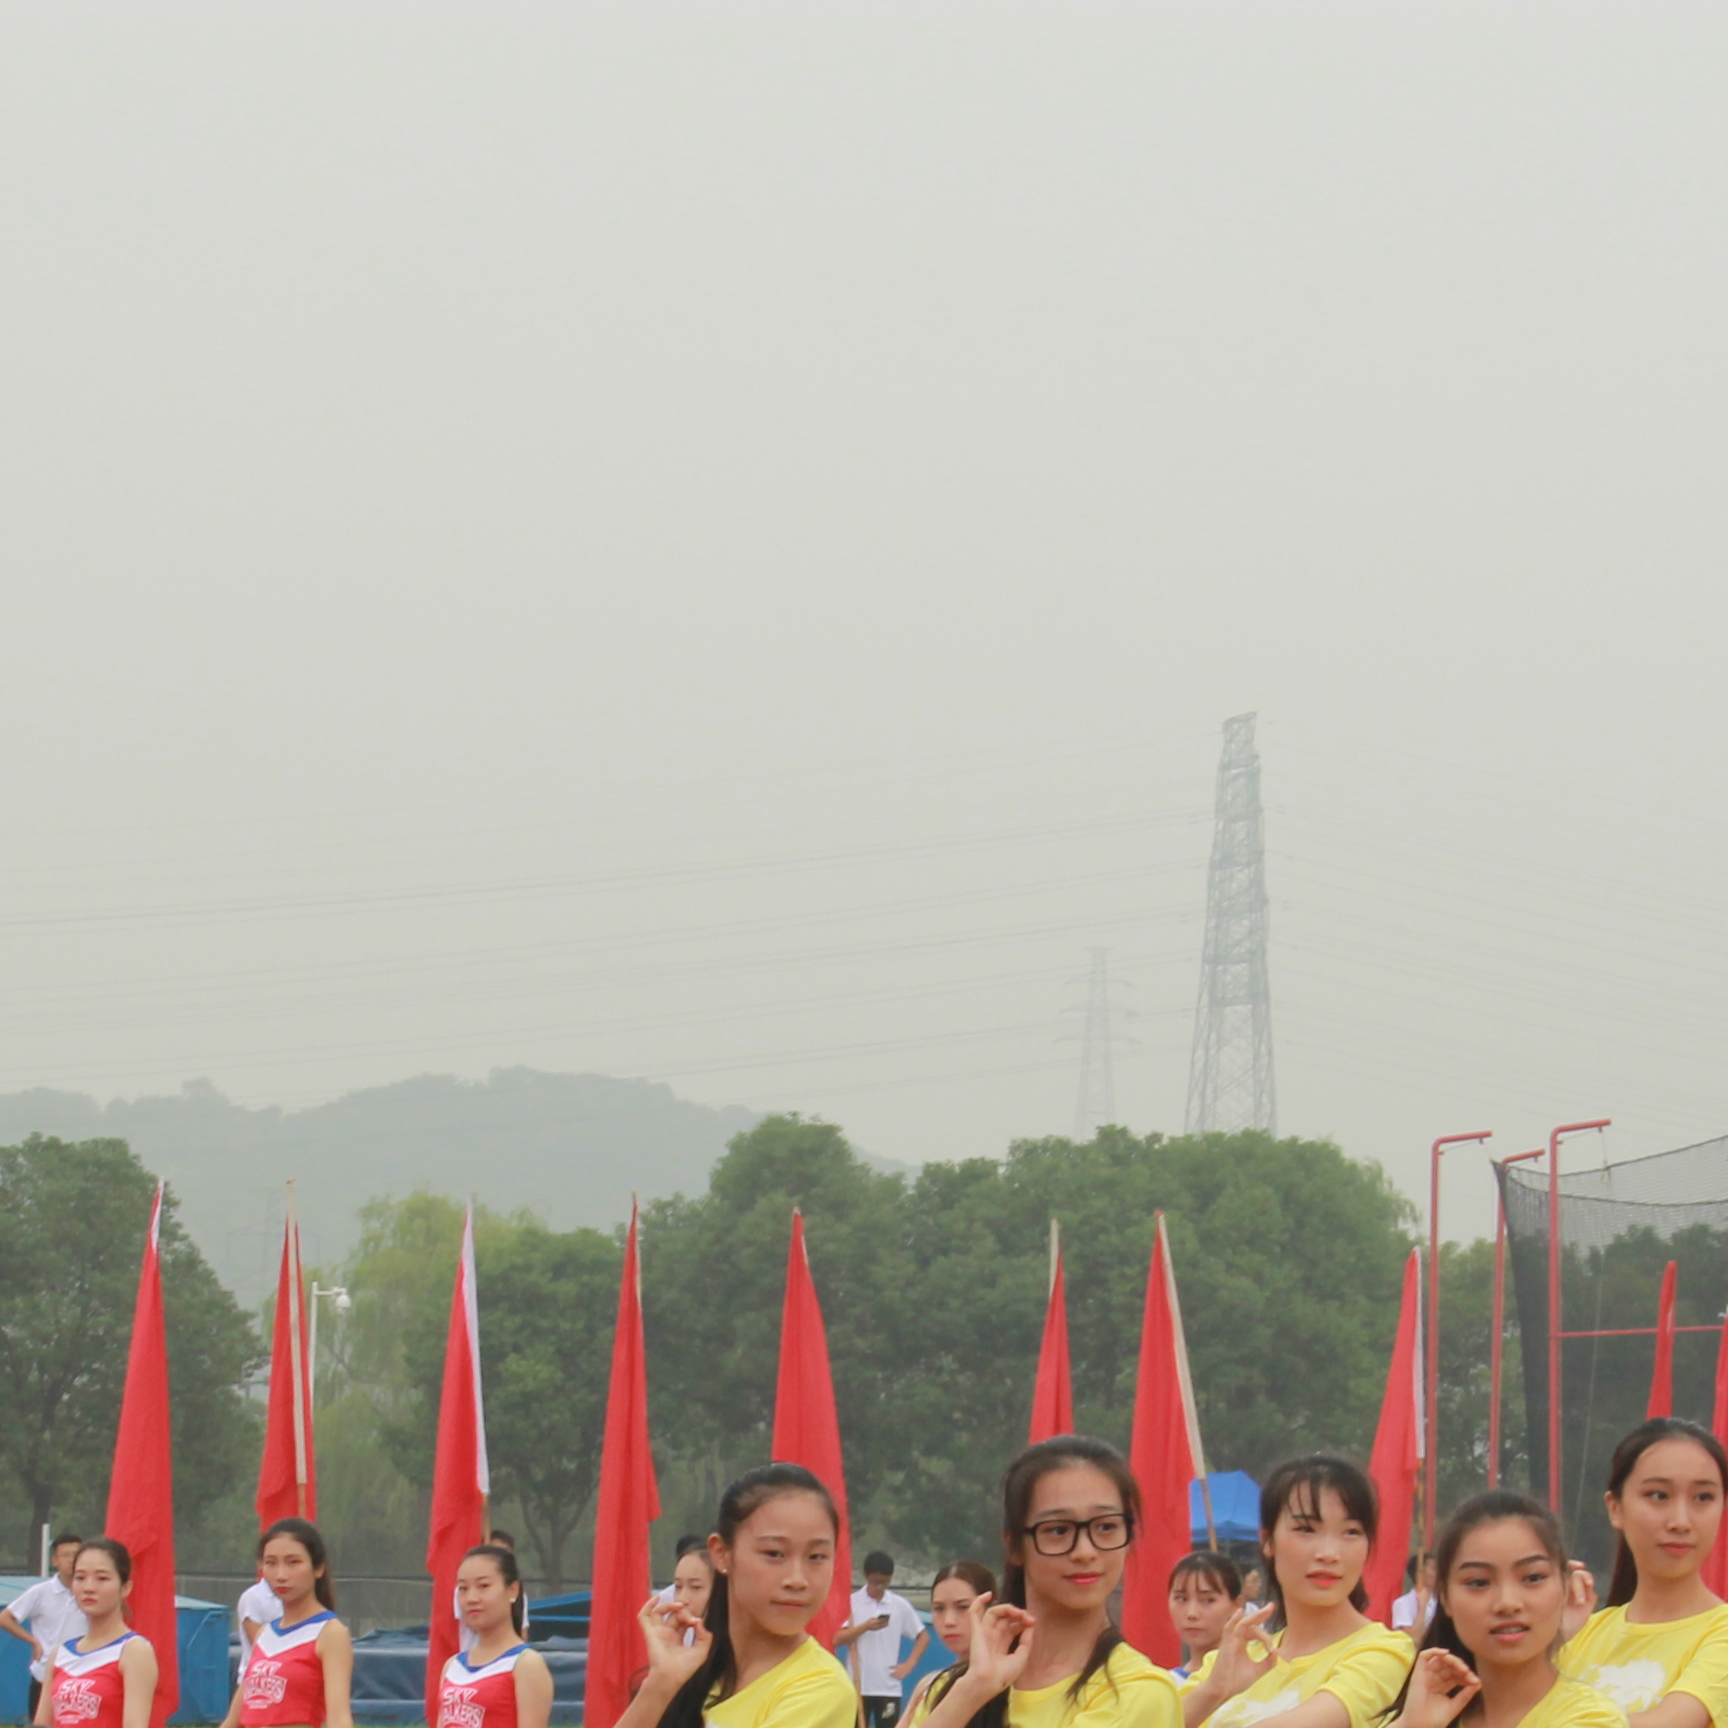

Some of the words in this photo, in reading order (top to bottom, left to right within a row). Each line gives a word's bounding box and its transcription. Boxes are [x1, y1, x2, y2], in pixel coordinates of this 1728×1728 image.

[251, 1661, 282, 1677] SKY
[59, 1679, 95, 1694] SKY
[443, 1687, 478, 1705] SKY
